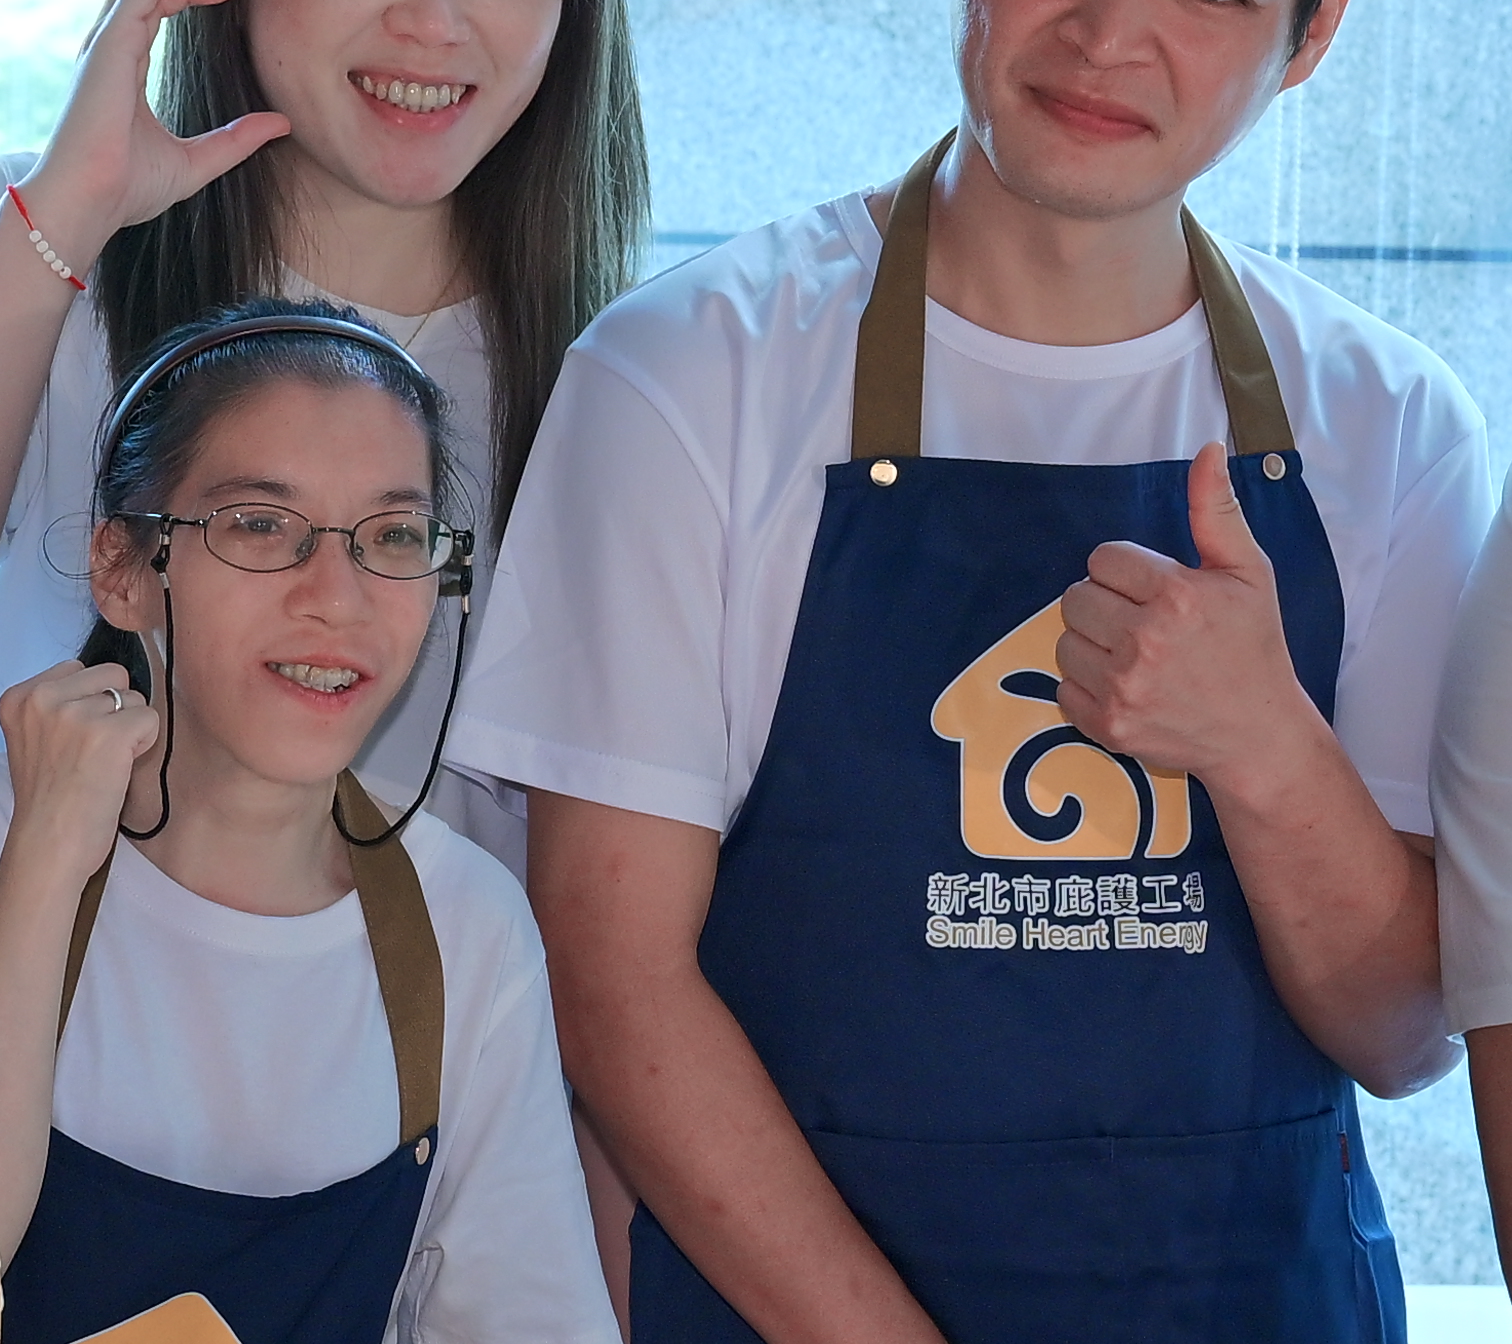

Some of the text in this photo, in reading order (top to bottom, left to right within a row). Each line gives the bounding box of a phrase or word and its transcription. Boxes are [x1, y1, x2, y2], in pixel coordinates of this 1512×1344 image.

[927, 872, 1205, 916] 新北市庇護工場
[926, 917, 1208, 954] Smile Heart Energy
